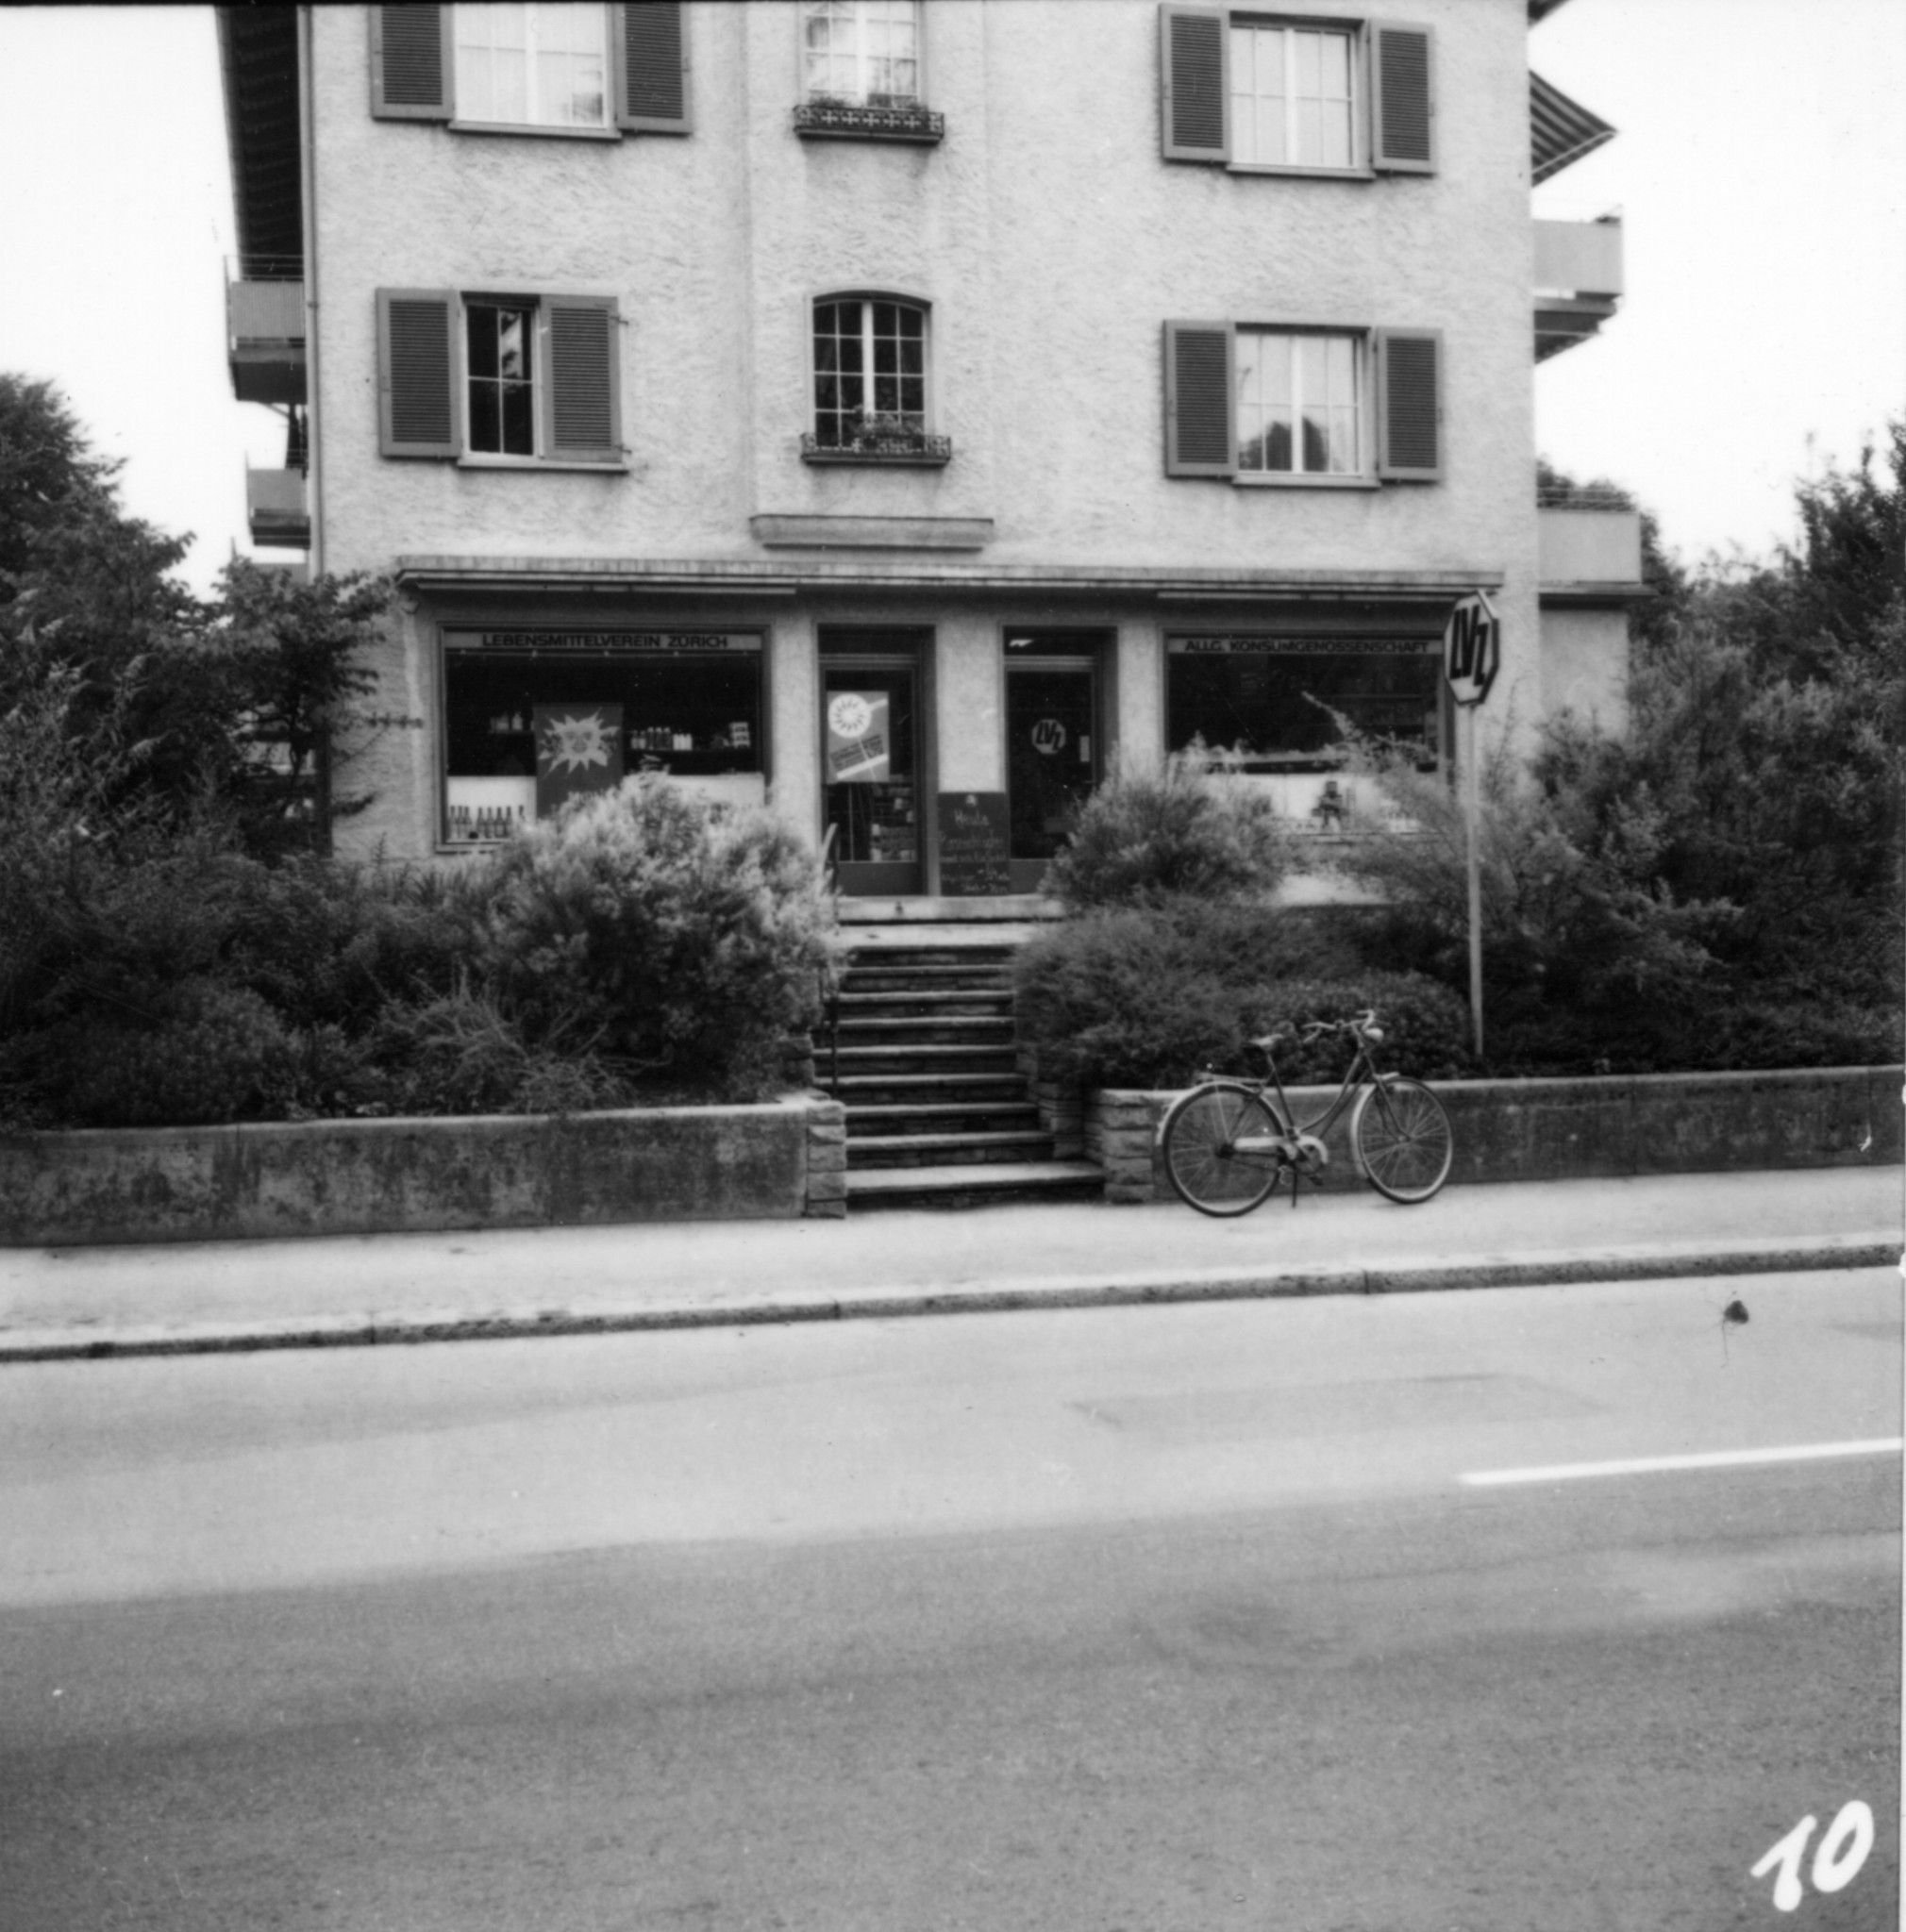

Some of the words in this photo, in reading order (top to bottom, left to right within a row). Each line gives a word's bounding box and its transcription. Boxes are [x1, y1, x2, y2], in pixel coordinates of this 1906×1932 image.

[482, 634, 660, 647] LEBENSMITTELVEREIN
[1185, 641, 1224, 653] ALLG.
[1230, 641, 1429, 654] KONSUMGENOSSENSCHAFT
